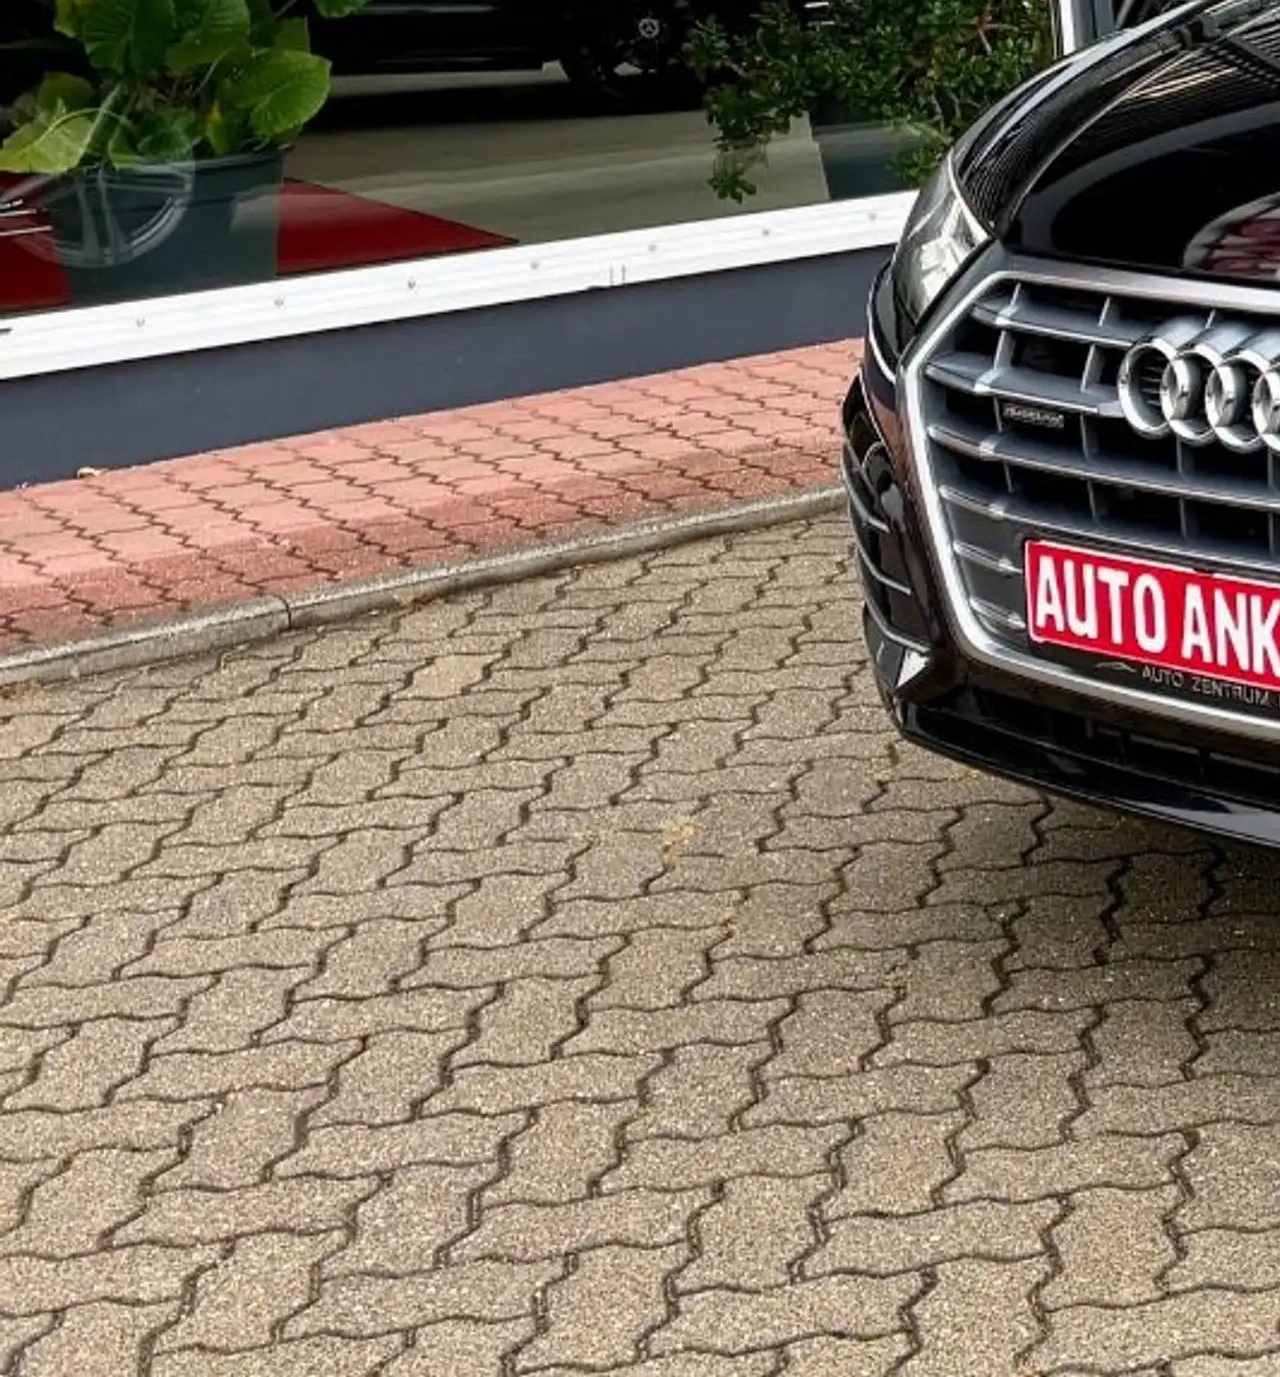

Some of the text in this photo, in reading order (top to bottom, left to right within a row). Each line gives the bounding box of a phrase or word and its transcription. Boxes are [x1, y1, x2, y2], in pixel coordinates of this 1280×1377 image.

[1035, 555, 1167, 653] AUTO
[1141, 665, 1184, 688] AUTO
[1191, 675, 1272, 707] ZENTRUM
